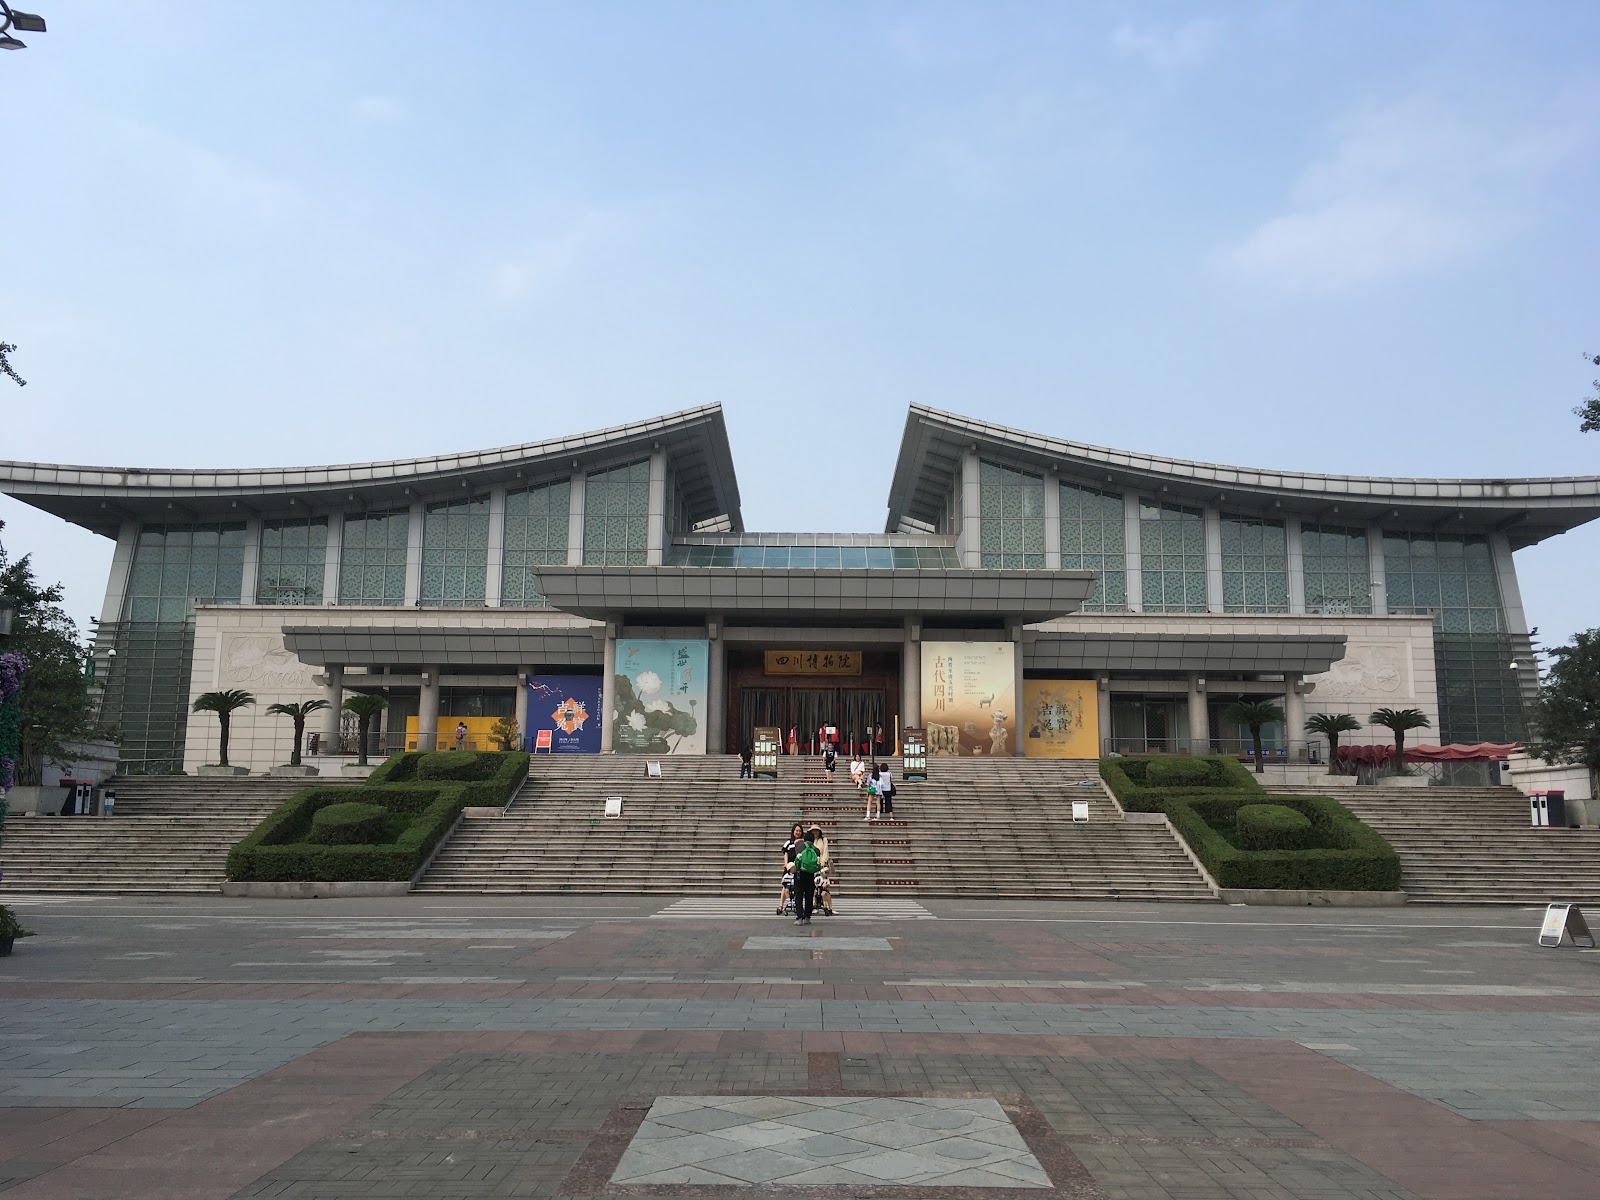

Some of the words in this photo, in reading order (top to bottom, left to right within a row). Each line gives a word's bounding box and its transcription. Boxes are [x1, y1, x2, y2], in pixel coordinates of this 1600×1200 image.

[775, 653, 851, 669] 四川博物院
[933, 656, 946, 711] 古代四川
